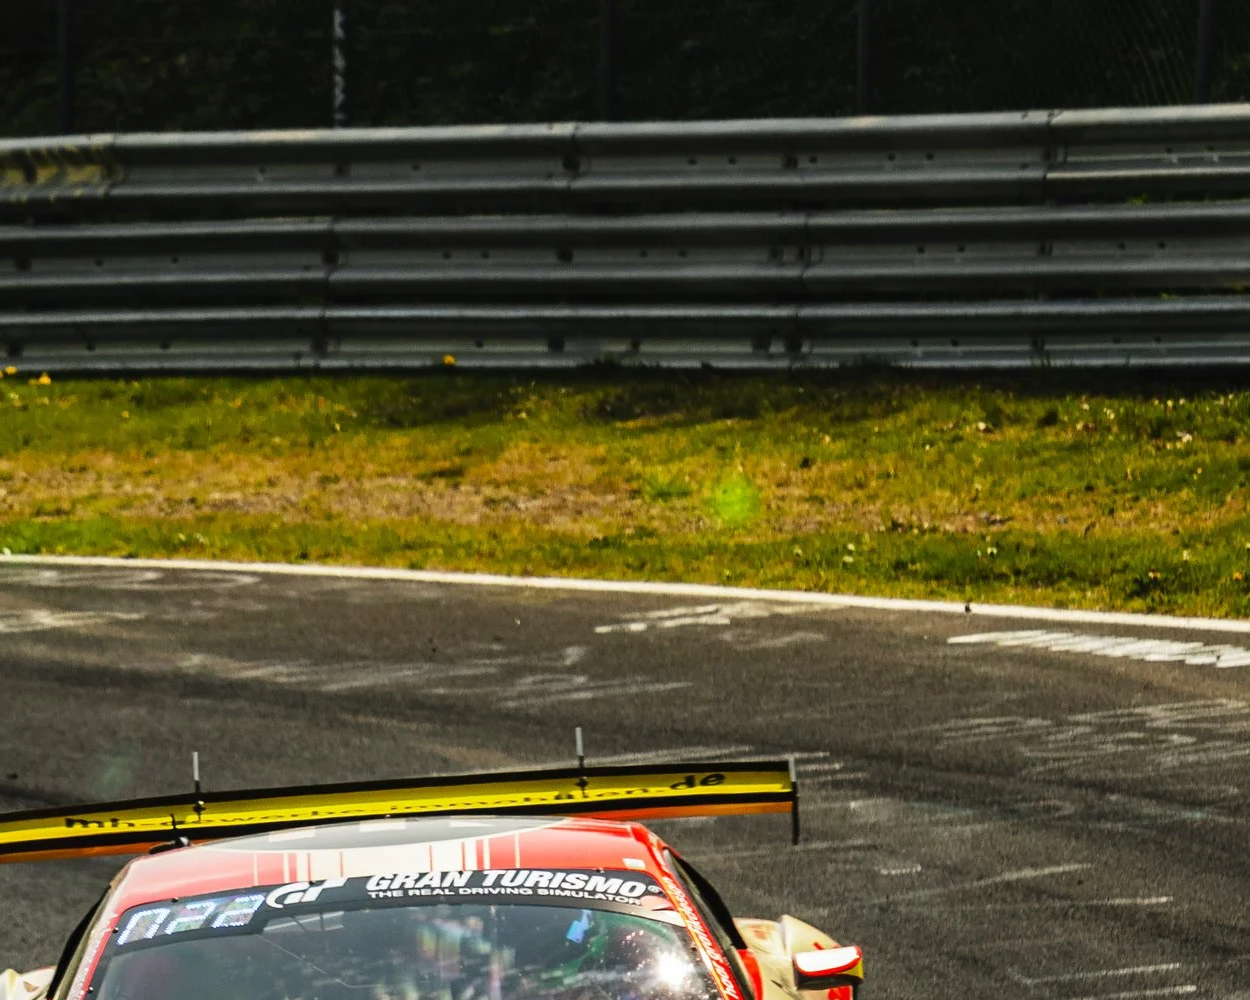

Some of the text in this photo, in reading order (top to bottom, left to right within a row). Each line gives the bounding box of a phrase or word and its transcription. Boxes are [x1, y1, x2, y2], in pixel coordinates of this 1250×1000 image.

[366, 870, 469, 891] GRAN
[368, 886, 642, 906] THE REAL DRIVING SIMULATOR
